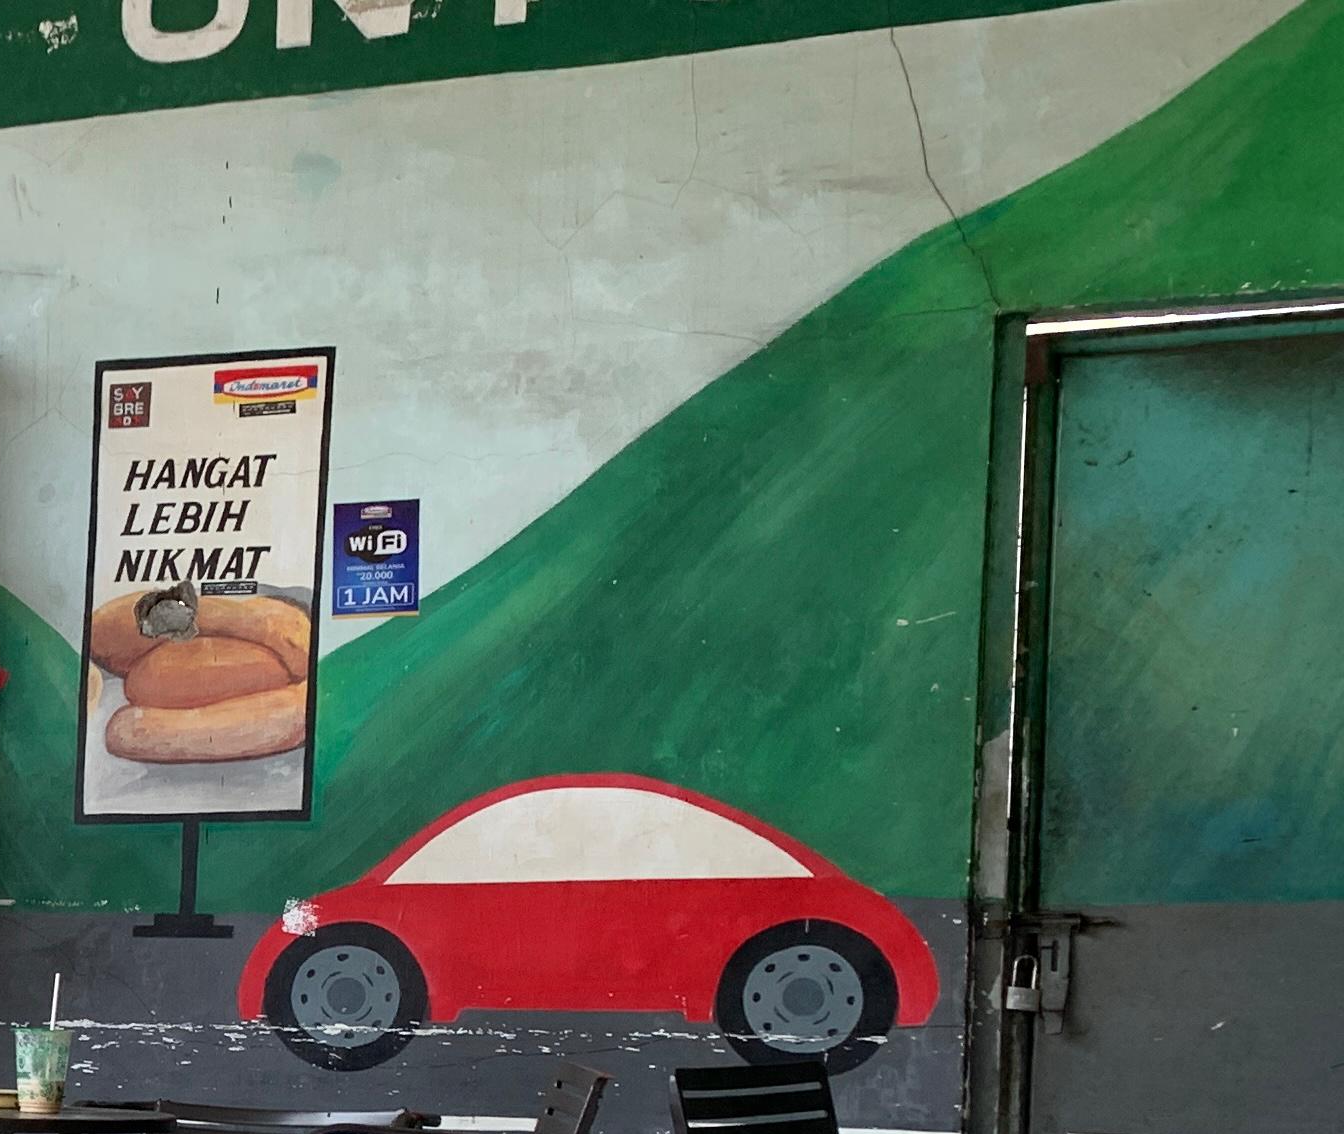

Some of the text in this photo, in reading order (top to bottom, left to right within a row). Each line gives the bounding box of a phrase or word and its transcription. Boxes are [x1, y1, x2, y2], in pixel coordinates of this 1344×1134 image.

[123, 454, 277, 492] HANGAT
[120, 500, 251, 537] LEBIH
[114, 546, 271, 583] NIKMAT
[344, 585, 408, 606] 1 JAM
